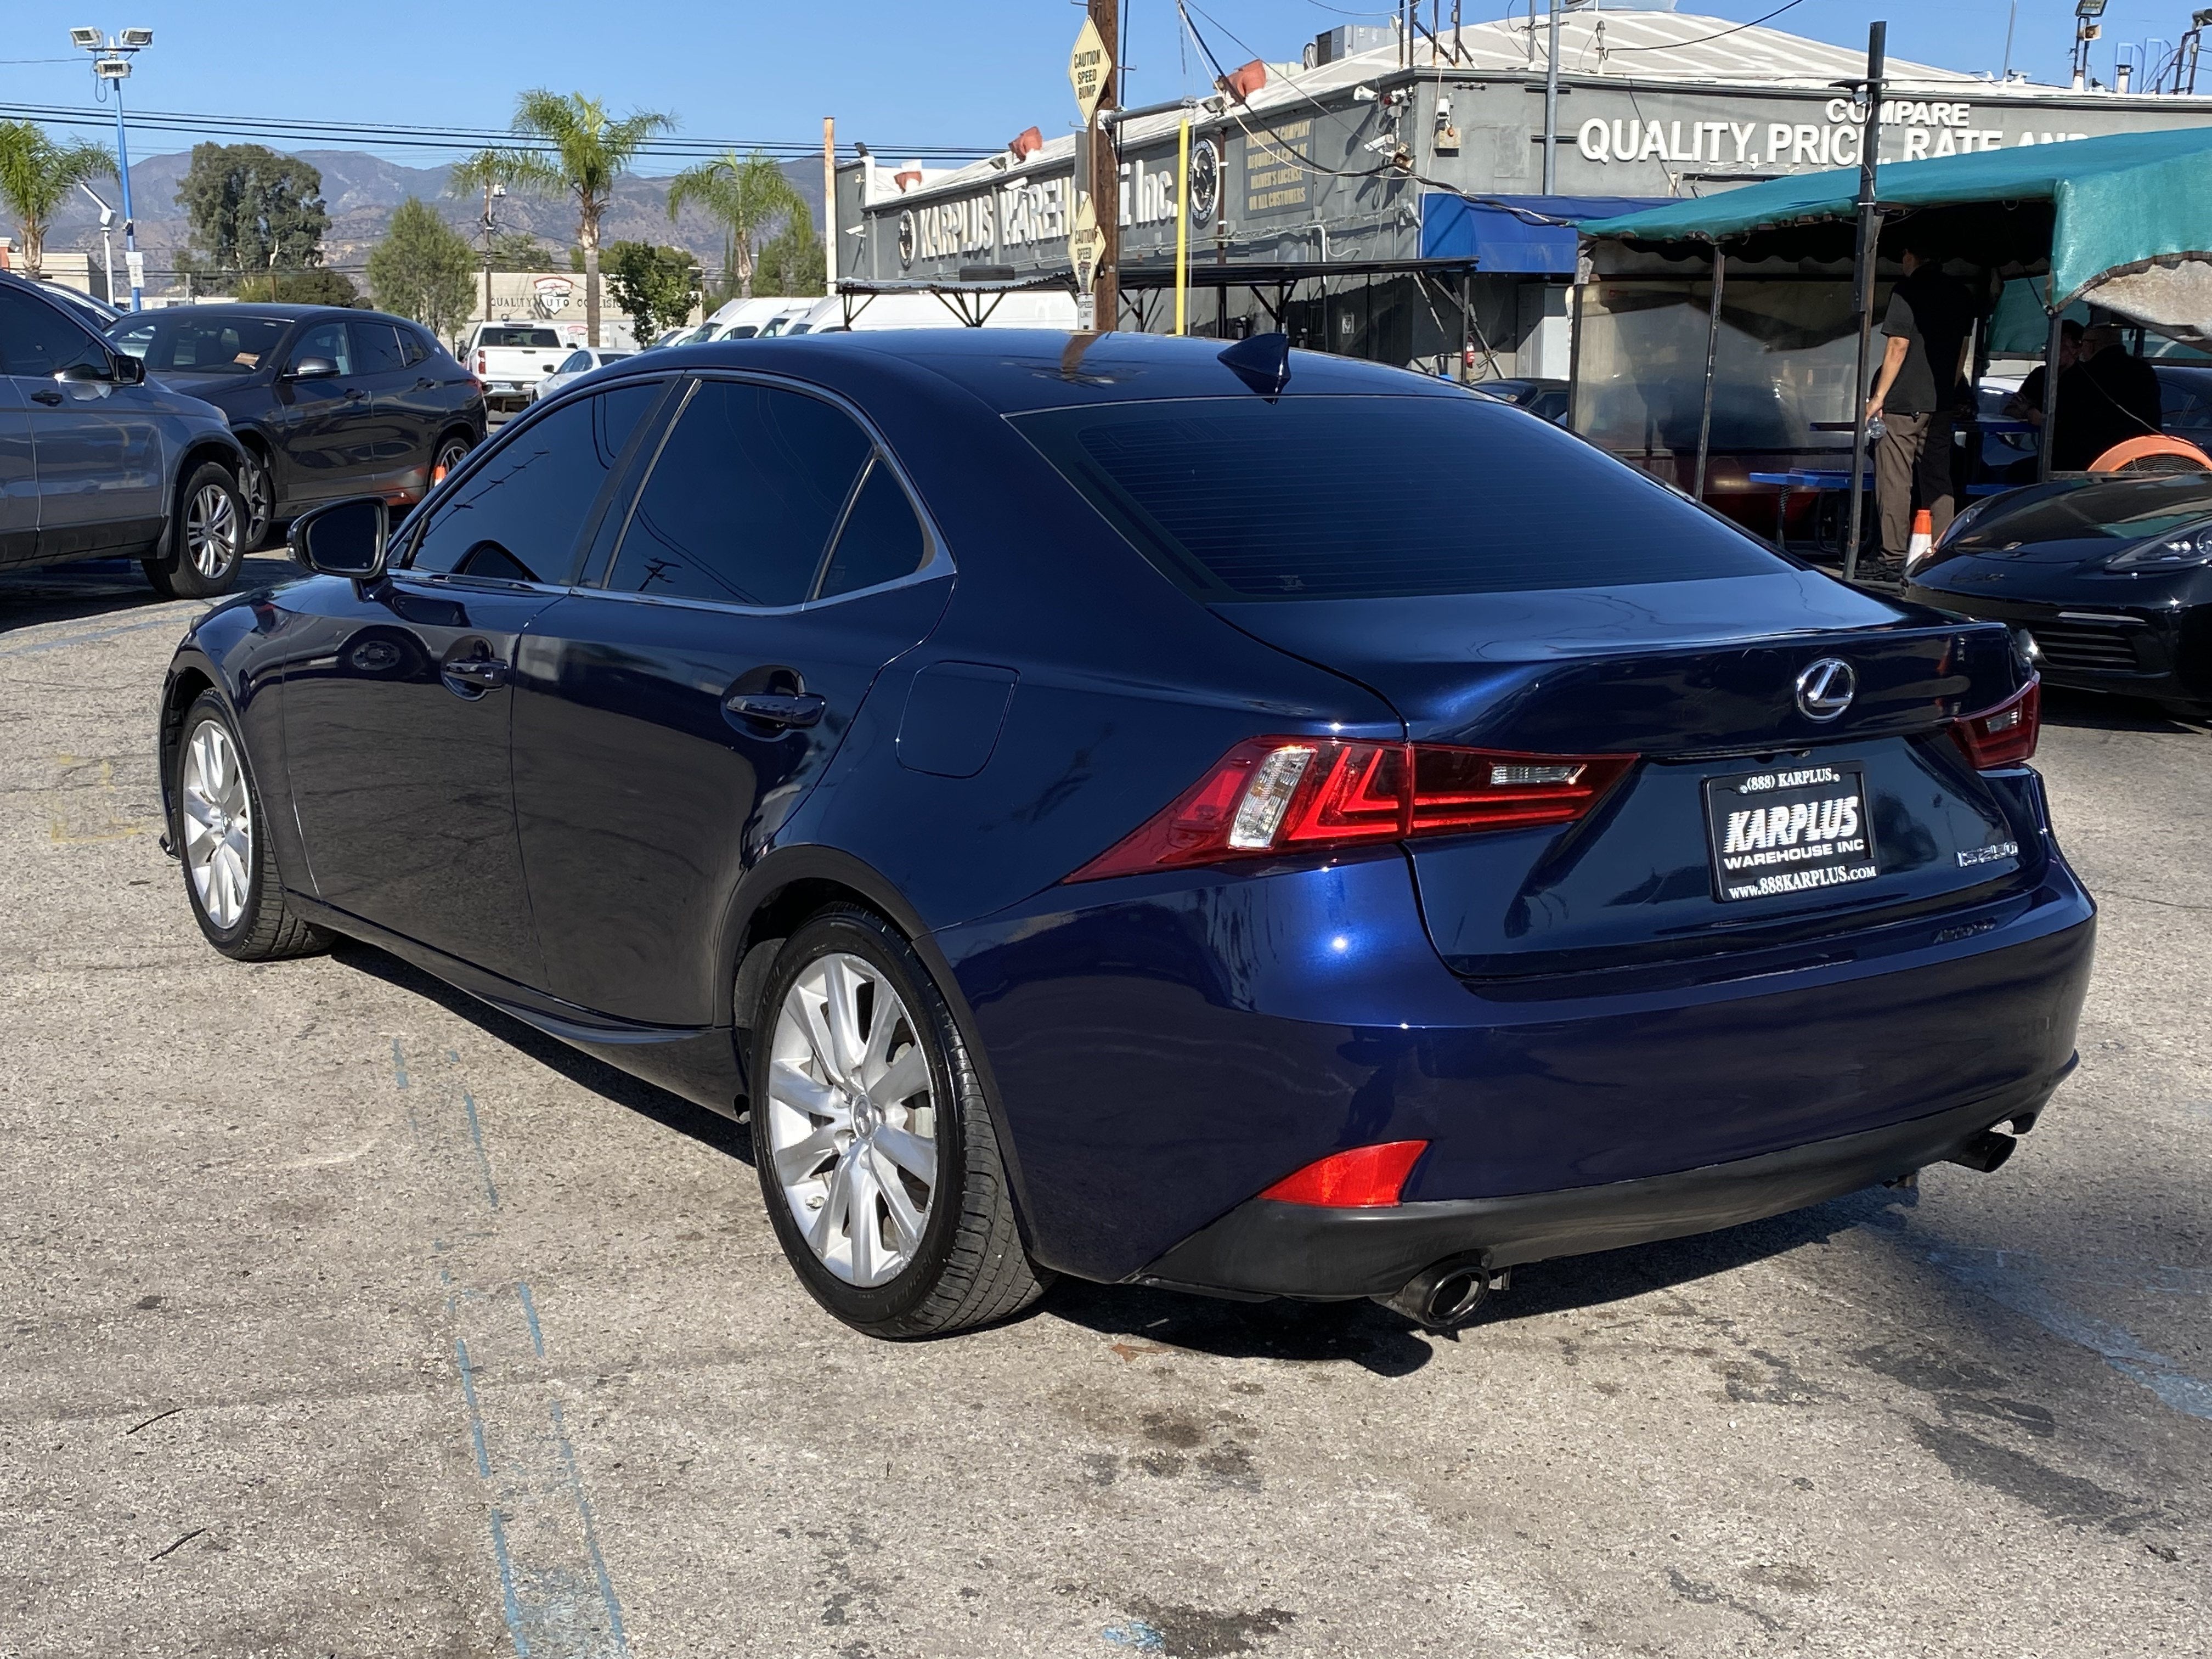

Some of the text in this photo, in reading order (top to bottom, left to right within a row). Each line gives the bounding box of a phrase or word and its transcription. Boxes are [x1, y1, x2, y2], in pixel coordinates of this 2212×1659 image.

[1075, 49, 1101, 69] CAUTION
[1077, 69, 1097, 84] SPEED
[1079, 84, 1096, 100] BUMP
[1826, 98, 1970, 127] COMPARE
[1577, 117, 1759, 168] QUALITY,
[1903, 127, 2004, 162] RATE
[920, 195, 994, 258] KARPLUS
[1136, 159, 1178, 223] Inc.
[491, 297, 535, 308] QUALITY
[577, 298, 624, 308] COISIO
[1746, 768, 1832, 791] (888) KARPLUS
[1723, 795, 1859, 853] KARPLUS
[1724, 839, 1864, 870] WAREHOUSE INC
